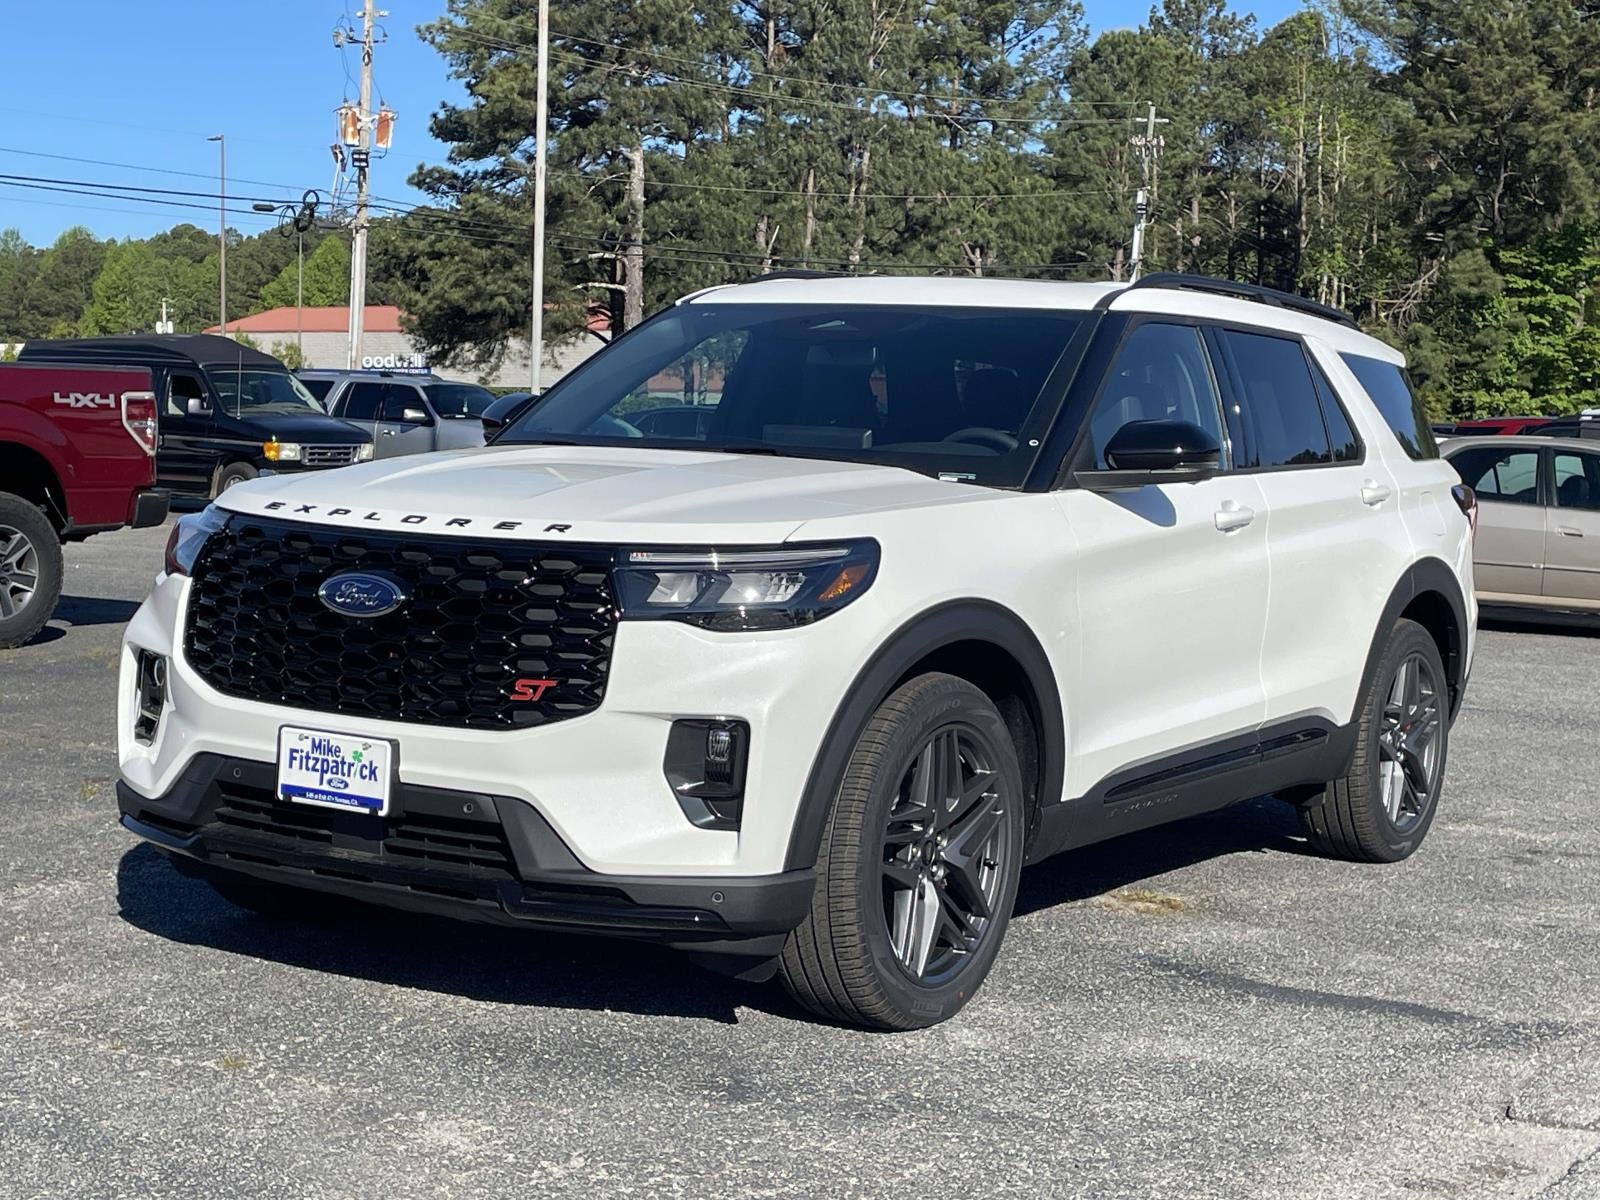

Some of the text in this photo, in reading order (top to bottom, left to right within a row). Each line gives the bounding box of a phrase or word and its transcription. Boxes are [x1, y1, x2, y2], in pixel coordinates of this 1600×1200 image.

[361, 353, 422, 368] oodwill
[264, 501, 573, 533] EXPLORER
[510, 679, 557, 701] ST
[311, 737, 342, 759] Mike
[288, 747, 379, 786] Fitzpatrick
